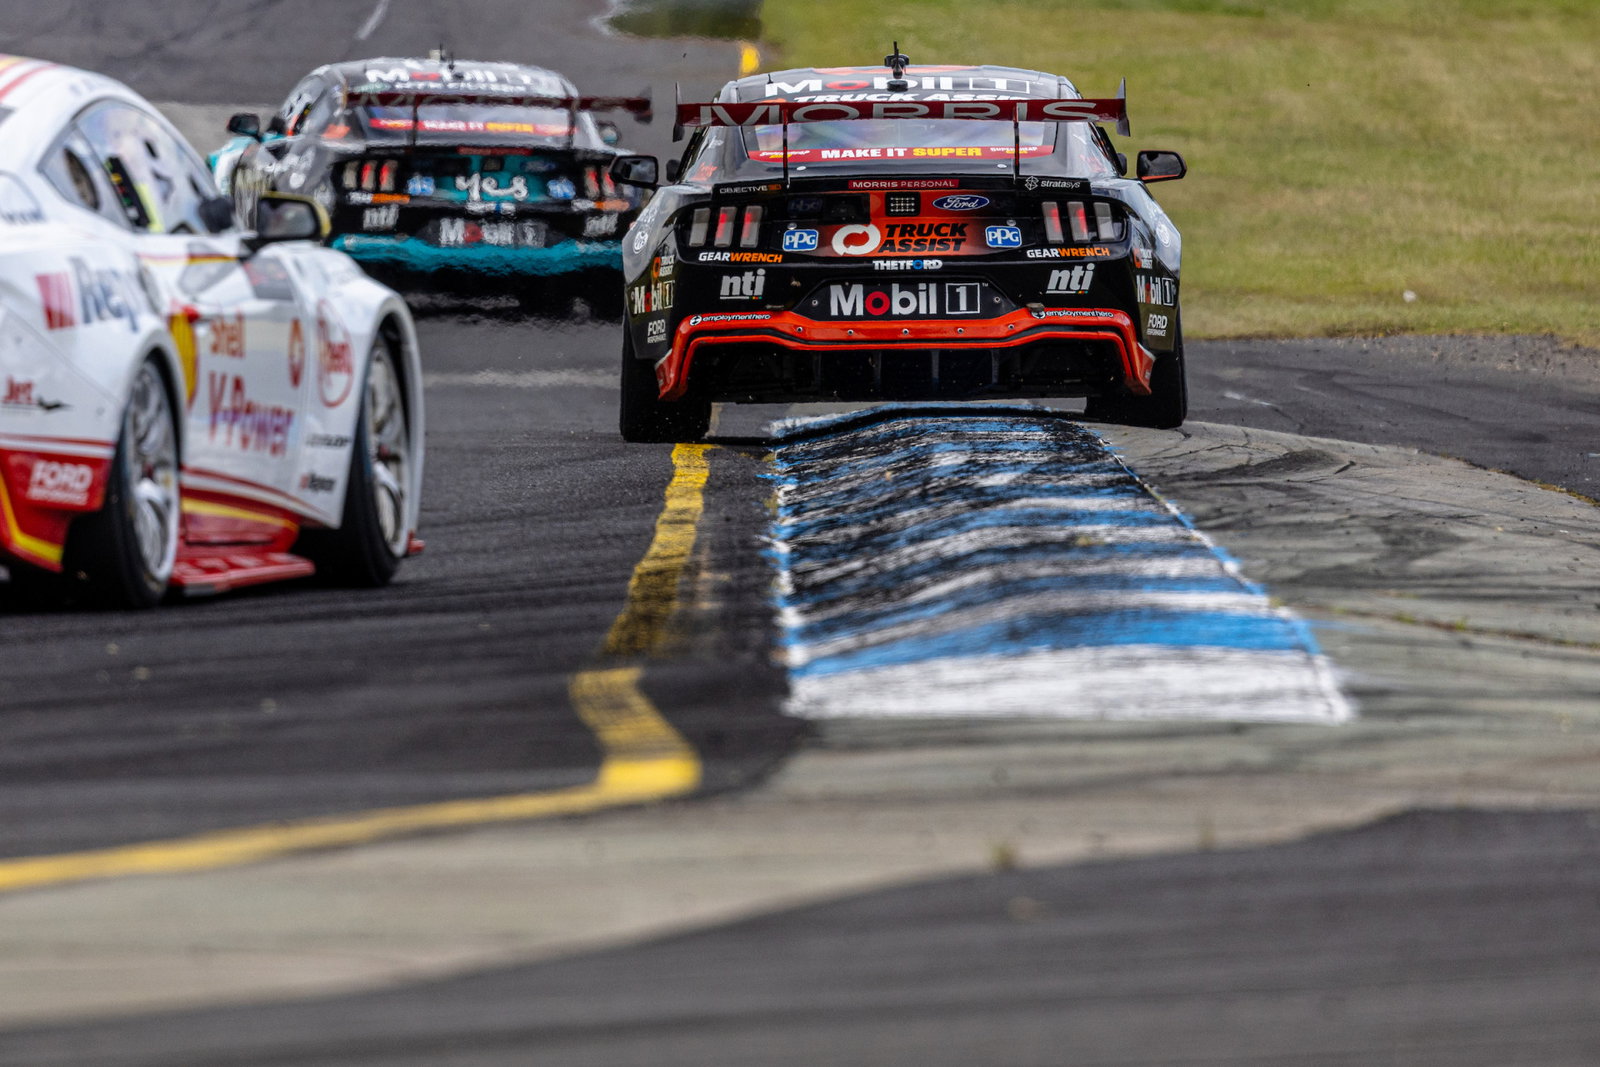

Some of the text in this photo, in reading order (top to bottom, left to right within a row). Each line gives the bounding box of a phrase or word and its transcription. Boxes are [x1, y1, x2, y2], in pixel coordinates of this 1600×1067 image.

[765, 76, 953, 97] Mobil
[699, 102, 1099, 125] MORRIS
[821, 147, 982, 159] MAKE IT SUPER
[900, 180, 955, 188] PERSONAL
[1040, 179, 1081, 190] stratasys
[942, 196, 980, 210] Ford
[885, 223, 969, 238] TRUCK
[988, 228, 1020, 246] PPG
[785, 231, 816, 248] PPG
[877, 238, 967, 253] ASSIST
[698, 252, 783, 263] GEARWRENCH
[1027, 247, 1110, 258] GEARWRENCH
[872, 259, 943, 270] THETFORD
[720, 268, 766, 296] nti
[1047, 263, 1095, 291] nti
[633, 281, 663, 314] Mobil
[1136, 275, 1162, 305] Mobil
[830, 283, 937, 316] Mobil
[702, 313, 772, 323] employmenthero
[1046, 309, 1114, 318] employmenthero
[1148, 313, 1168, 330] FORD
[648, 319, 666, 336] FORD
[32, 460, 93, 492] FORD
